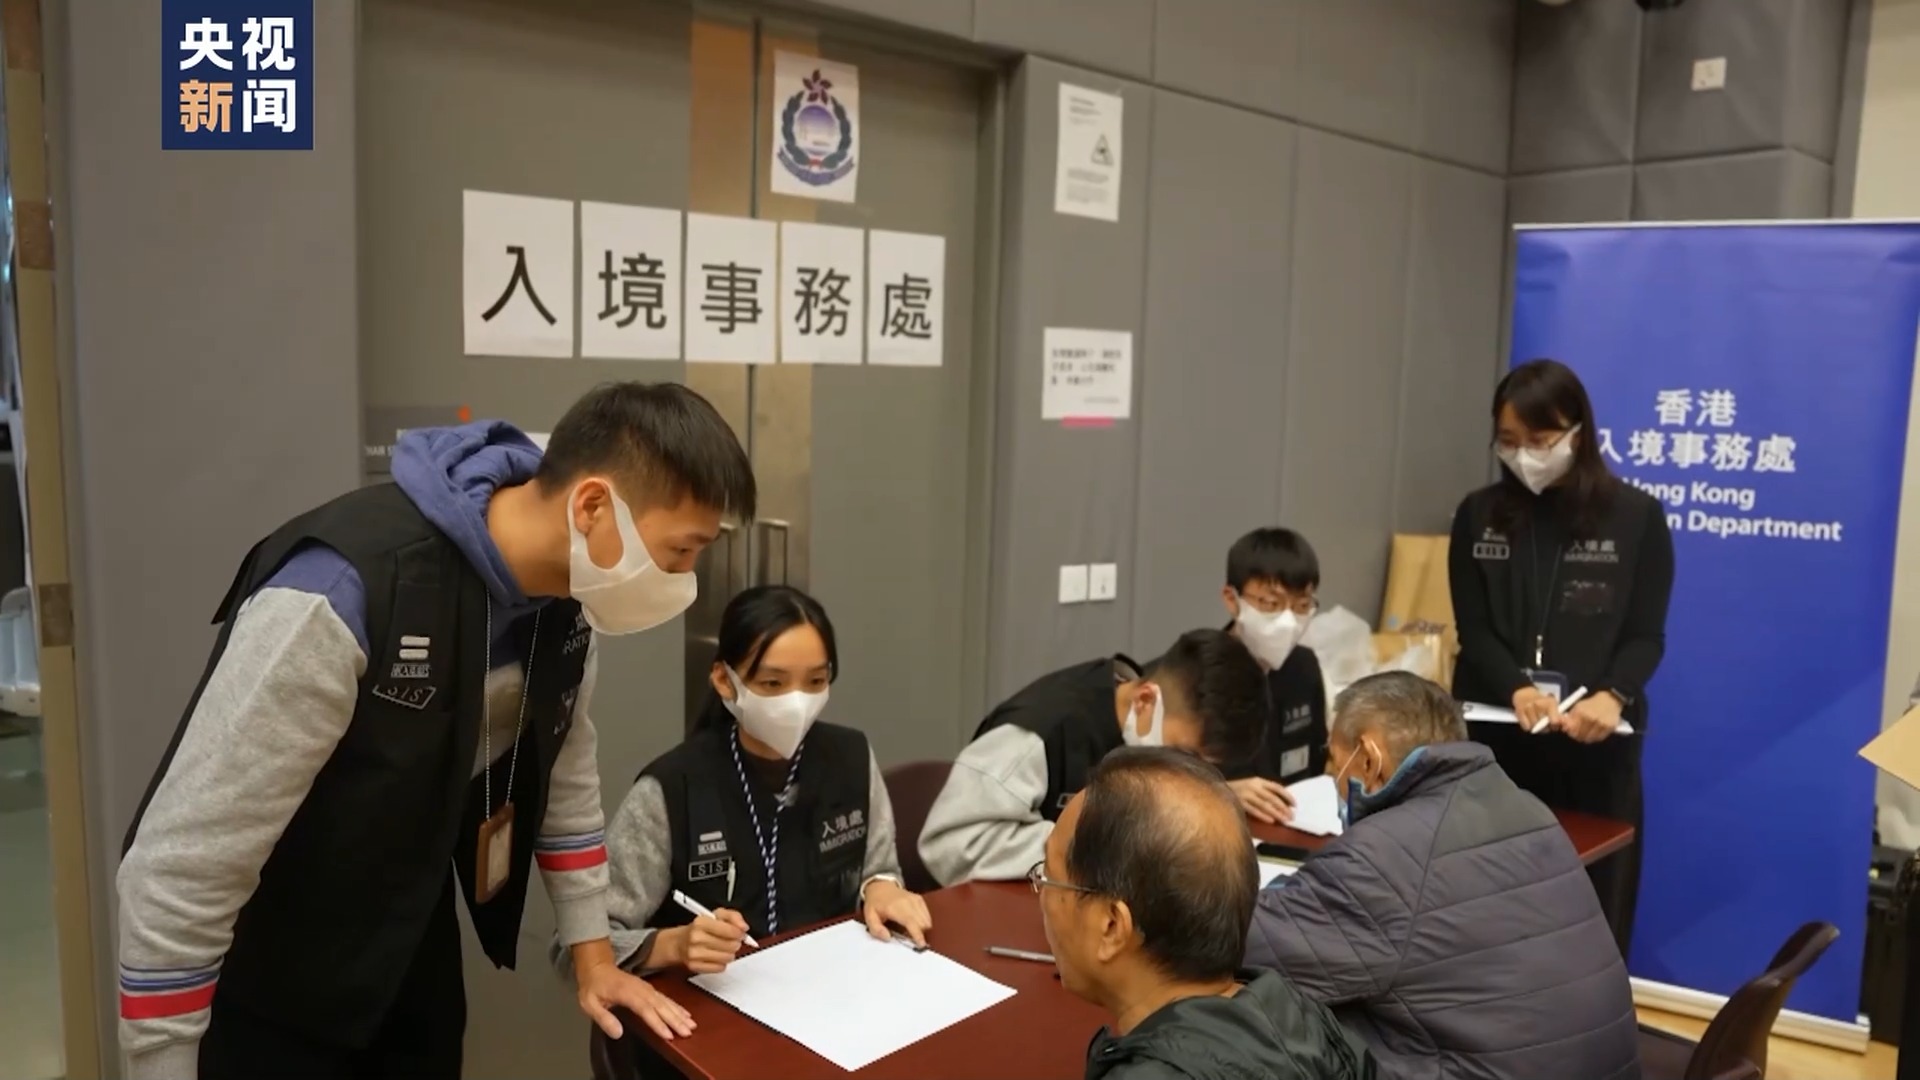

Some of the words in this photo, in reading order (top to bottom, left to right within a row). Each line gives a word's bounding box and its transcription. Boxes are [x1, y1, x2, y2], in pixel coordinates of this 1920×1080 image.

[480, 244, 933, 341] 入境事務處
[1655, 388, 1737, 427] 香港
[1598, 428, 1797, 473] 入境事務處
[1622, 477, 1685, 507] ong
[1690, 480, 1756, 510] Kong
[1687, 509, 1843, 542] Department
[698, 860, 723, 876] SIS
